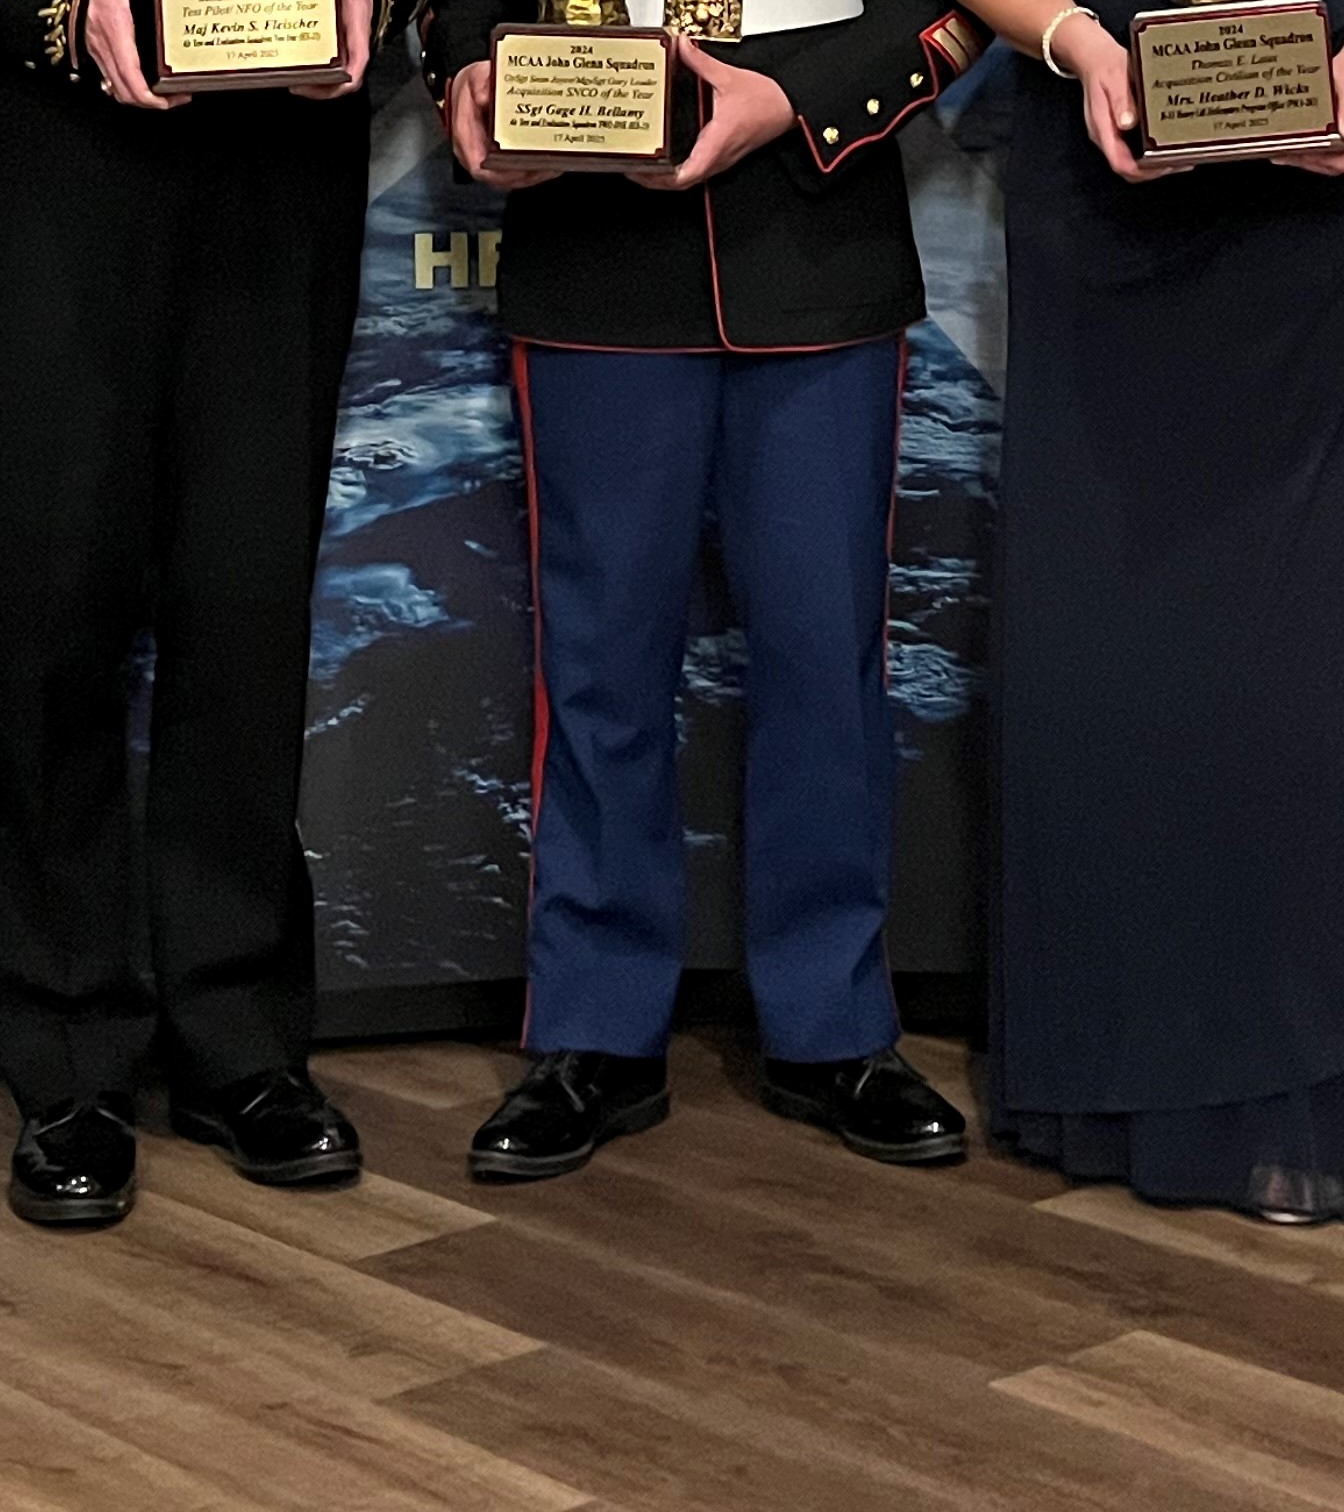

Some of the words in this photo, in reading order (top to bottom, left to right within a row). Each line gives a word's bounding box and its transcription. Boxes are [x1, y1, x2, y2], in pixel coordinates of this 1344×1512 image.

[236, 3, 261, 15] NFO
[264, 2, 275, 15] of
[277, 2, 293, 12] the
[295, 1, 318, 10] Year
[183, 24, 207, 37] Maj
[210, 22, 244, 34] Kevin
[264, 19, 319, 30] Fleischer
[1219, 24, 1244, 36] 2024
[570, 45, 594, 54] 2024
[1152, 44, 1191, 57] MCAA
[1193, 41, 1221, 53] John
[1223, 38, 1257, 51] Glenn
[1259, 32, 1314, 49] Squadron
[507, 55, 544, 67] MCAA
[545, 56, 570, 68] John
[573, 56, 603, 69] Glenn
[605, 57, 655, 73] Squadron
[566, 87, 599, 98] SNCO
[600, 88, 613, 100] of
[613, 88, 629, 99] the
[631, 88, 654, 100] Year
[1166, 94, 1194, 107] Mrs.
[1198, 90, 1250, 104] Heather
[515, 103, 544, 118] SSgt
[545, 103, 576, 118] Gage
[597, 106, 645, 119] Bellamy
